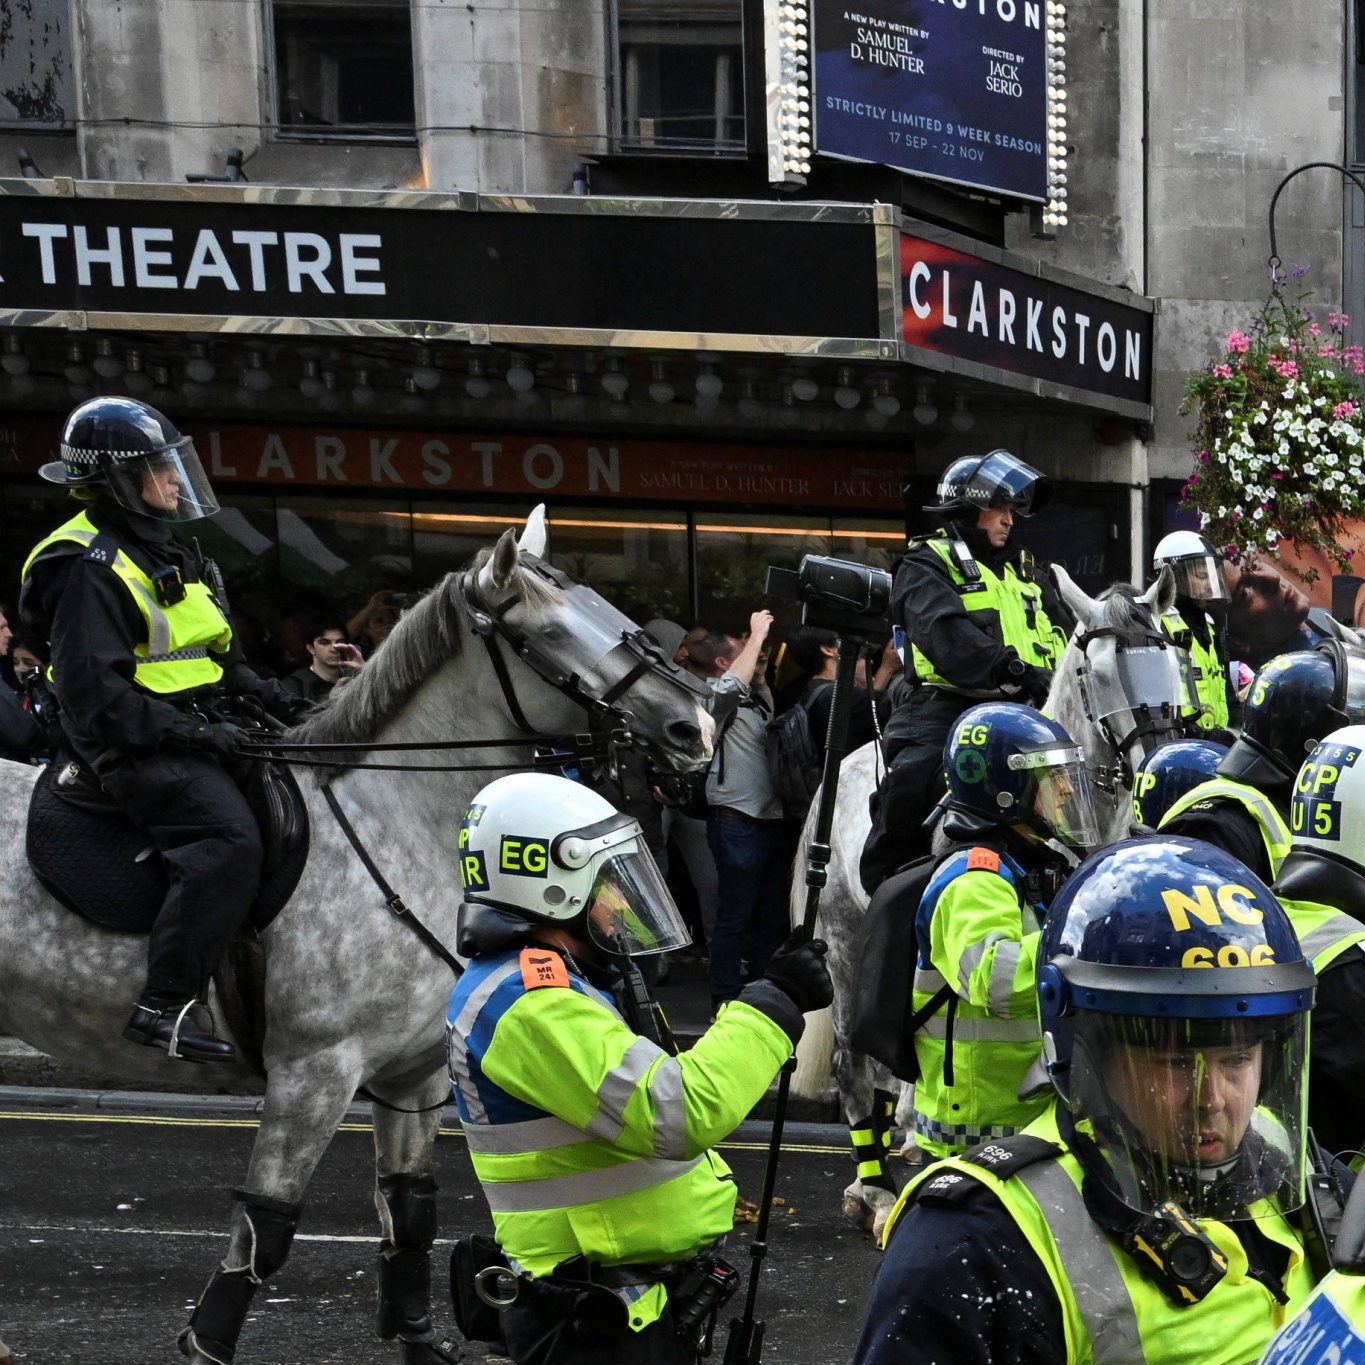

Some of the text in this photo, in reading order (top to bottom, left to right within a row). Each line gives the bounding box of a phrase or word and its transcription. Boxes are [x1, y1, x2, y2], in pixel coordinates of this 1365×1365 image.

[851, 13, 867, 24] NEW
[869, 17, 887, 29] PLAY
[888, 21, 919, 37] WRITTEN
[921, 30, 930, 40] BY
[857, 28, 913, 56] SAMUEL
[982, 46, 1025, 64] DIRECTED BY
[850, 43, 925, 75] D. HUNTER
[989, 60, 1019, 82] JACK
[986, 76, 1023, 98] SERIO
[826, 96, 1042, 156] STRICTLY LIMITED 9 WEEK SEASON
[889, 131, 902, 144] 17
[905, 134, 928, 151] SEP
[942, 142, 955, 157] 22
[960, 146, 985, 163] NOV
[21, 222, 387, 296] THEATRE
[909, 260, 1141, 381] CLARKSTON
[209, 430, 622, 492] LARKSTON
[639, 470, 710, 492] SAMUEL
[738, 475, 811, 496] HUNTER
[958, 724, 988, 746] EG
[1298, 763, 1339, 795] CP
[501, 840, 547, 873] EG
[1160, 883, 1265, 933] NC
[537, 966, 553, 976] MR
[539, 972, 556, 982] 241
[976, 1151, 1000, 1165] KIRK
[983, 1145, 1014, 1161] 696
